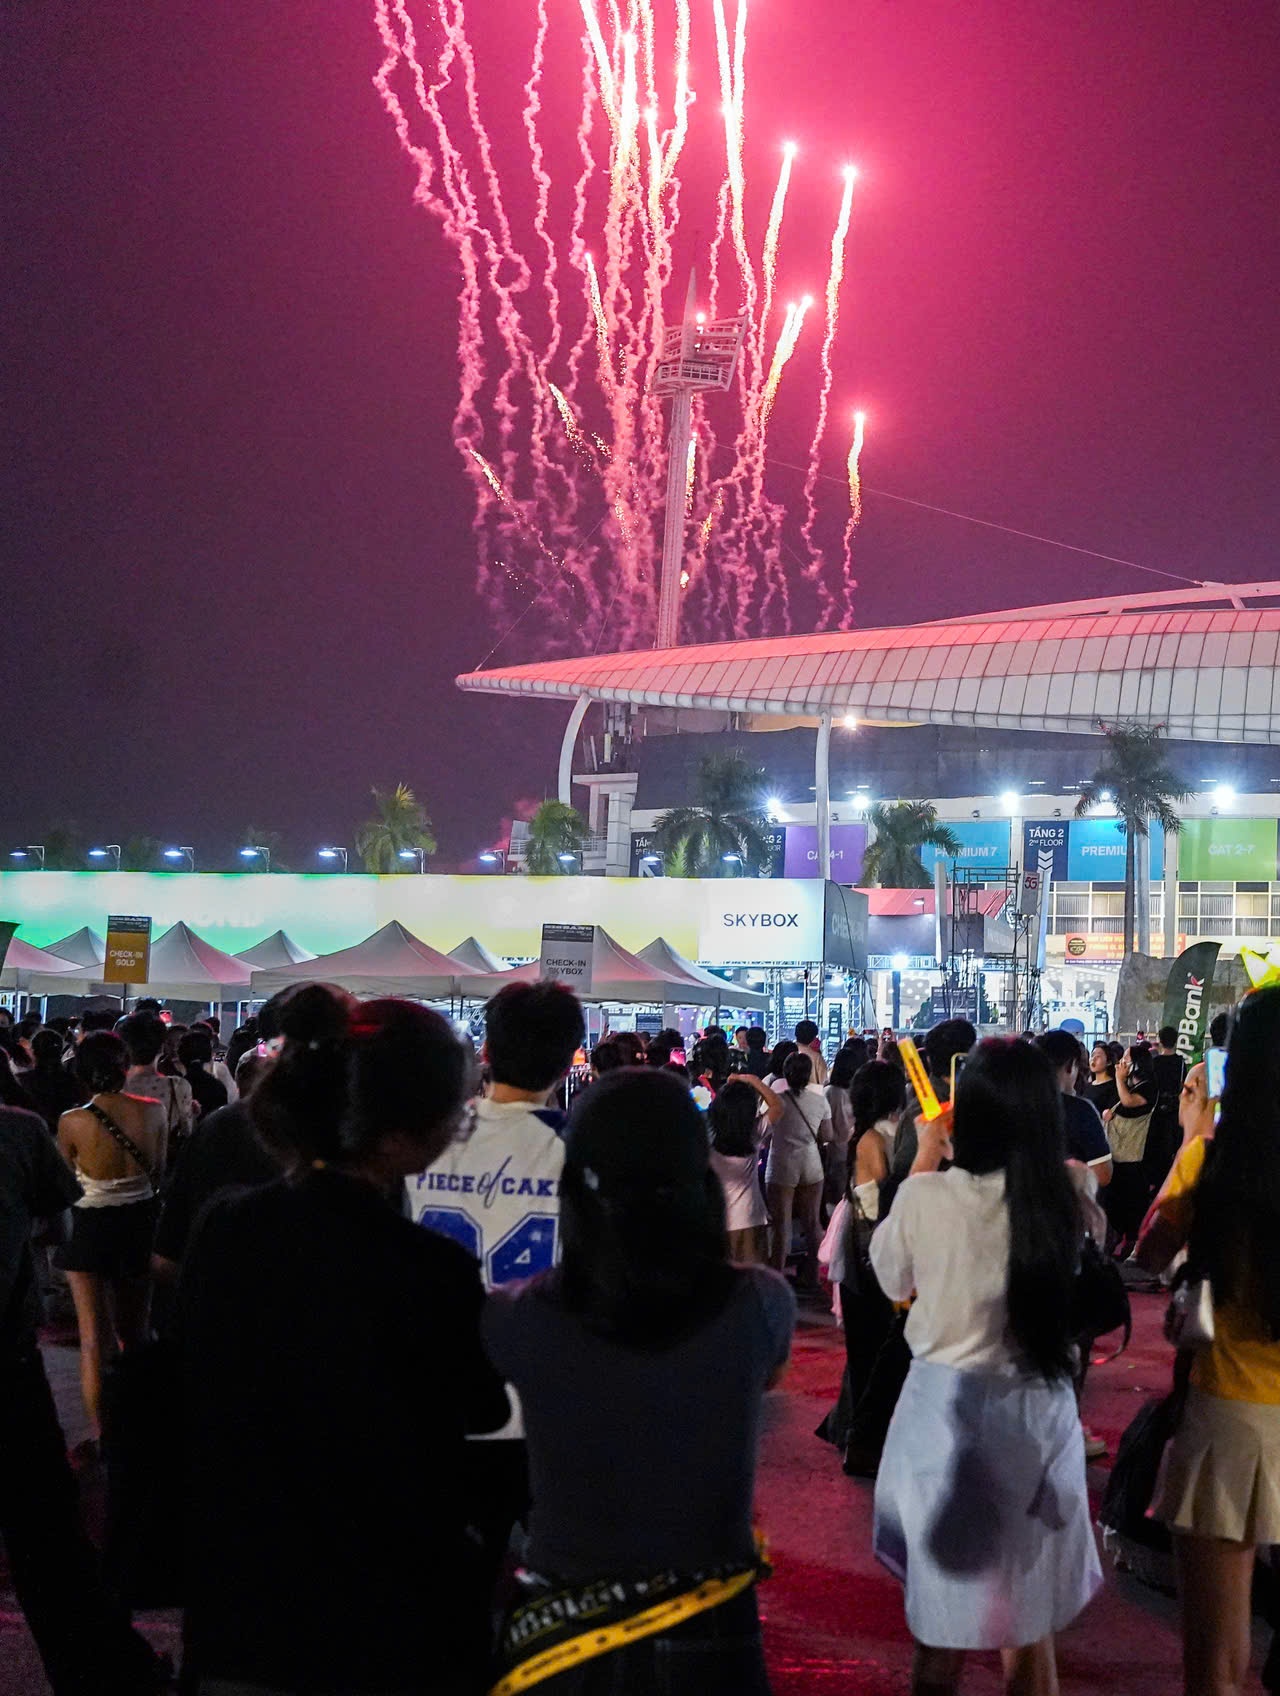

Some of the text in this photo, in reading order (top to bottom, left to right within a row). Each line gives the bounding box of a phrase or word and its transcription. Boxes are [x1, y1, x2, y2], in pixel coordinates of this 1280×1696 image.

[1058, 829, 1064, 838] 2
[776, 834, 782, 843] 2
[1039, 839, 1064, 847] FLOOR
[990, 846, 998, 856] 7
[1081, 846, 1129, 856] PREMIU
[1025, 876, 1038, 889] 5G
[723, 913, 799, 927] SKYBOX
[110, 950, 144, 959] CHECK-IN
[546, 959, 586, 967] CHECK-IN
[549, 967, 583, 975] SKYBOX
[1175, 974, 1205, 1064] VPBank
[416, 1155, 559, 1209] PIECE of CAK
